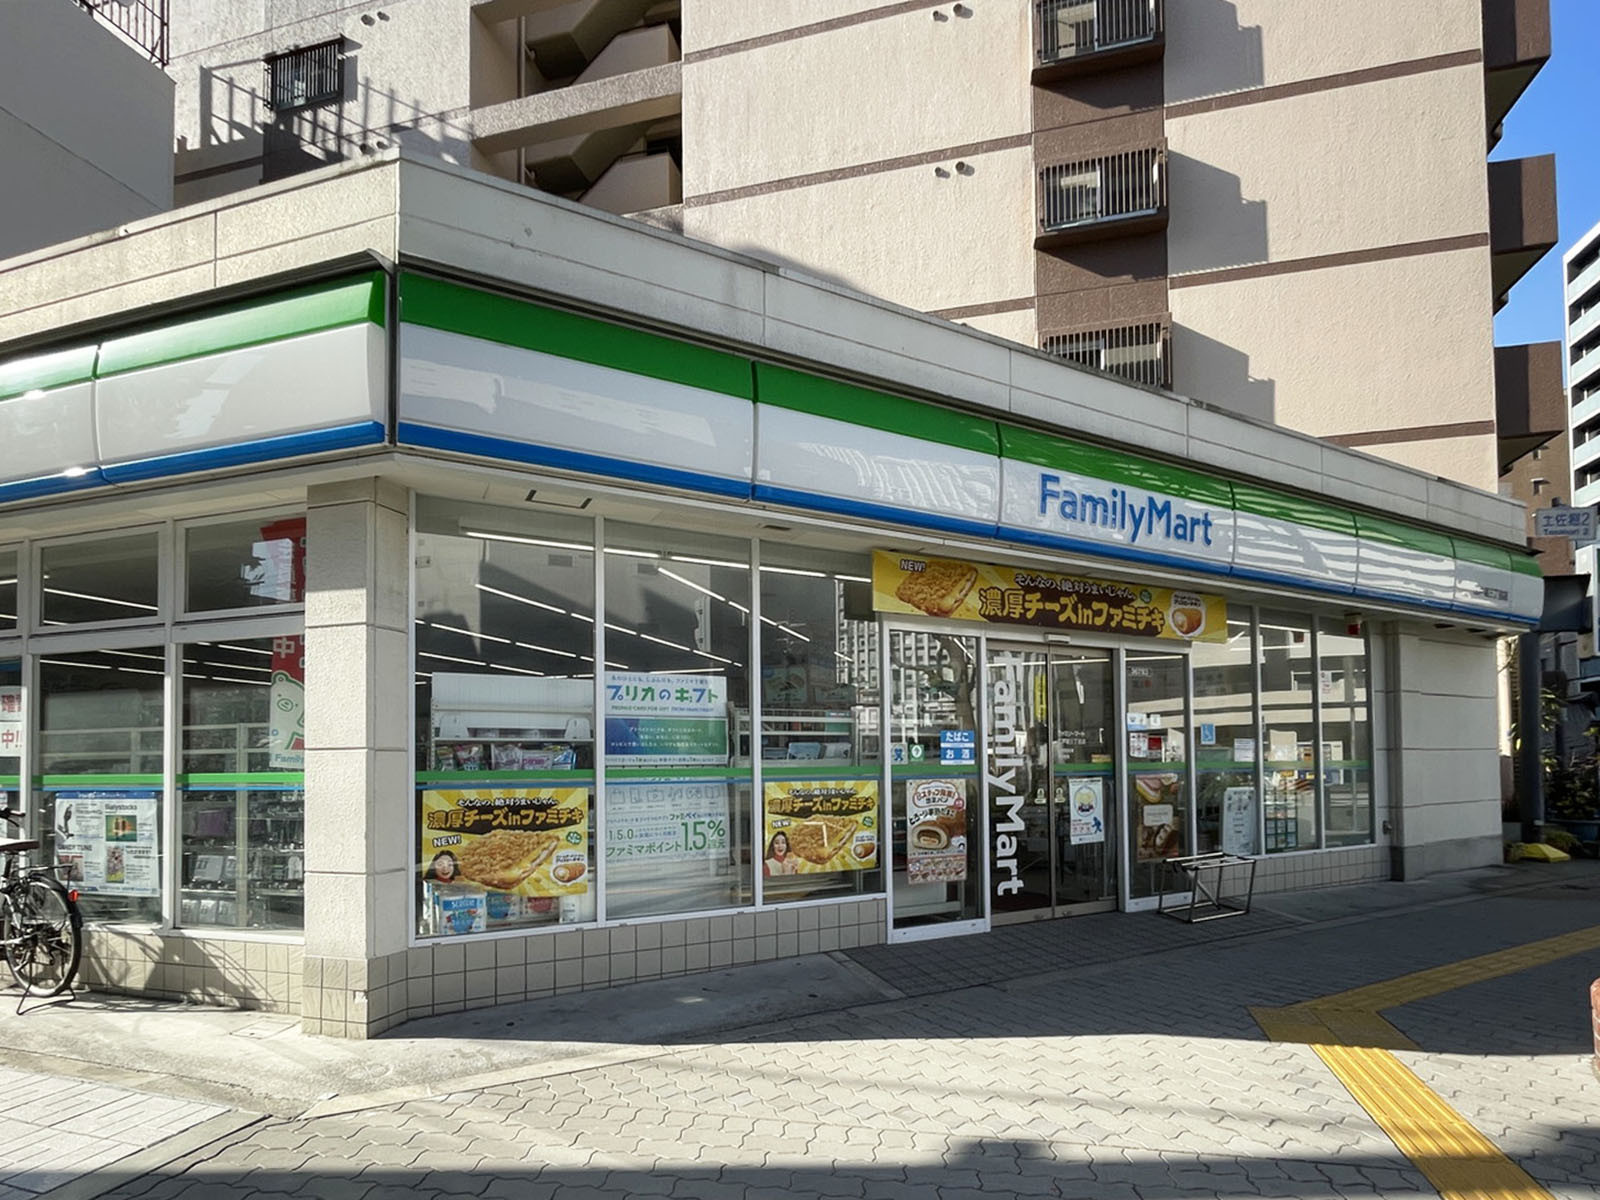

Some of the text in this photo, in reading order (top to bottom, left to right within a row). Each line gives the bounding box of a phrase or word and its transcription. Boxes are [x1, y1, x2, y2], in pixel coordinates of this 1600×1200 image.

[1039, 472, 1214, 547] FamilyMart
[900, 559, 927, 573] NEW!
[1014, 572, 1138, 600] そんなの、絶対うまいじゃん。
[978, 586, 1166, 634] 濃厚チーズinファミチキ
[945, 731, 969, 742] たばこ
[988, 655, 1026, 897] FamilyMart
[427, 807, 585, 829] 濃厚チーズinファミチキ
[432, 834, 462, 847] NEW!
[606, 841, 682, 858] ファミマポイント
